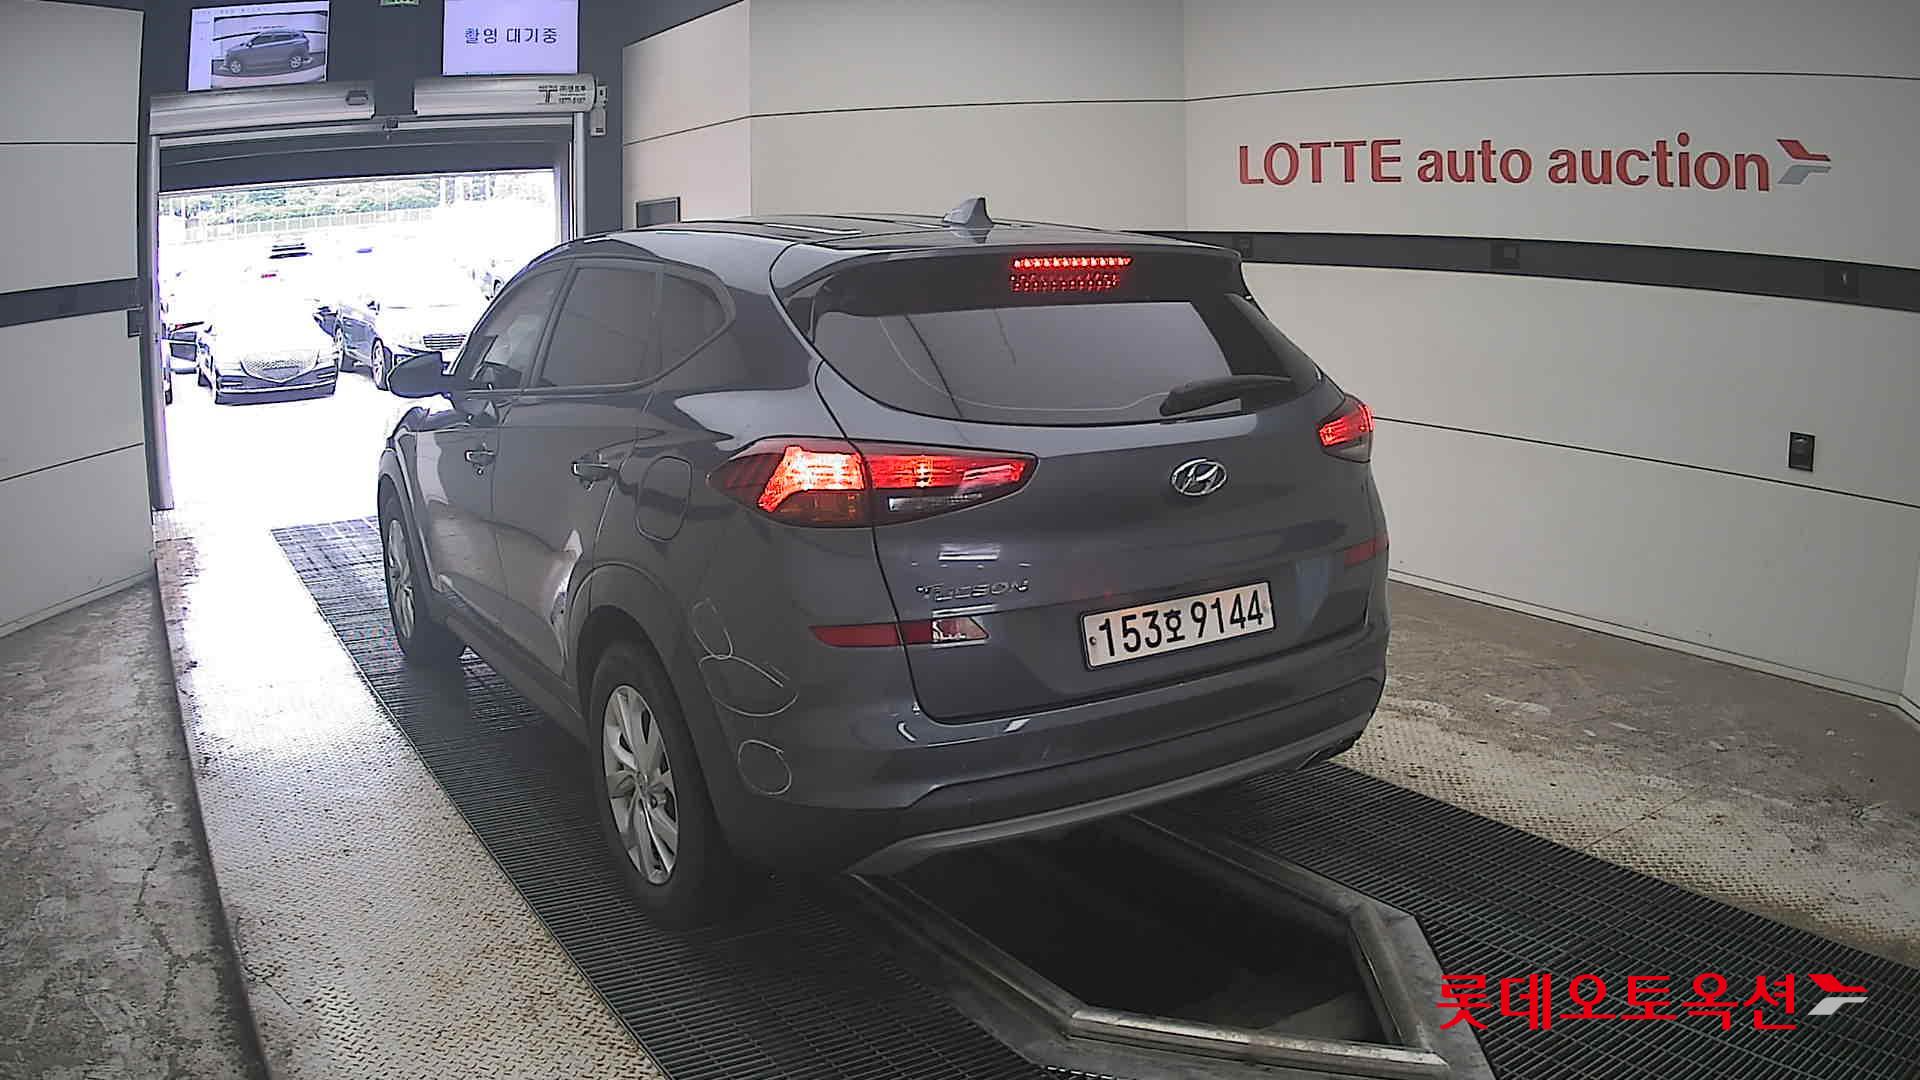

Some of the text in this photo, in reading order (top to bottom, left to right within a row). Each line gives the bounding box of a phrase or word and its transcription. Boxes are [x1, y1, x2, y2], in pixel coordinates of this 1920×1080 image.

[464, 27, 498, 44] 촬영
[1239, 131, 1770, 192] LOTTE auto auction
